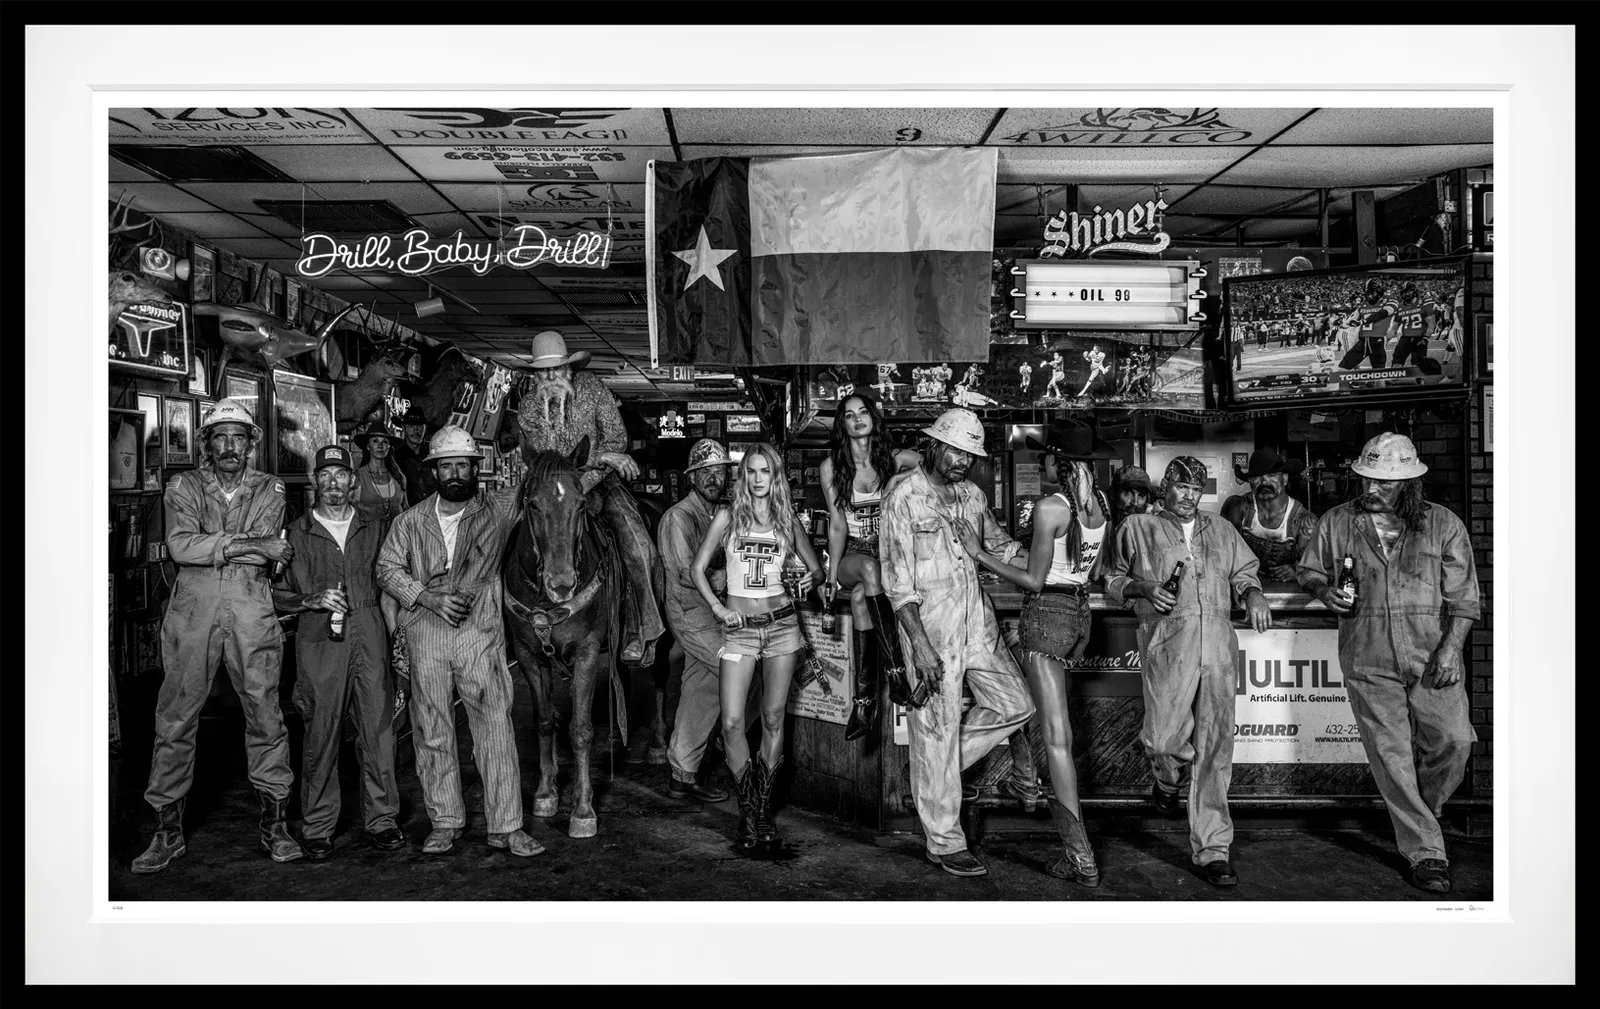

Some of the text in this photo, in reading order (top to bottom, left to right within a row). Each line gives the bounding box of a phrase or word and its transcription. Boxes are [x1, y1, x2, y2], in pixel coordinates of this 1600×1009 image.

[152, 120, 344, 131] SERVICES INC.
[390, 129, 538, 140] DOUBLE
[1001, 130, 1252, 144] 4WILLCO
[1040, 198, 1169, 258] Shiner
[298, 225, 610, 276] Drill, Baby, Drill!
[1080, 288, 1104, 302] OIL
[1402, 314, 1422, 329] 72
[674, 366, 691, 380] EXIT
[880, 366, 891, 374] 67
[1339, 370, 1406, 381] TOUCHDOWN
[1301, 376, 1317, 384] 30
[836, 384, 854, 400] 62
[661, 428, 683, 436] Modelo
[1081, 542, 1100, 552] Drill
[1250, 694, 1287, 702] Artificial
[1290, 694, 1306, 702] Lift.
[1309, 694, 1346, 702] Genuine
